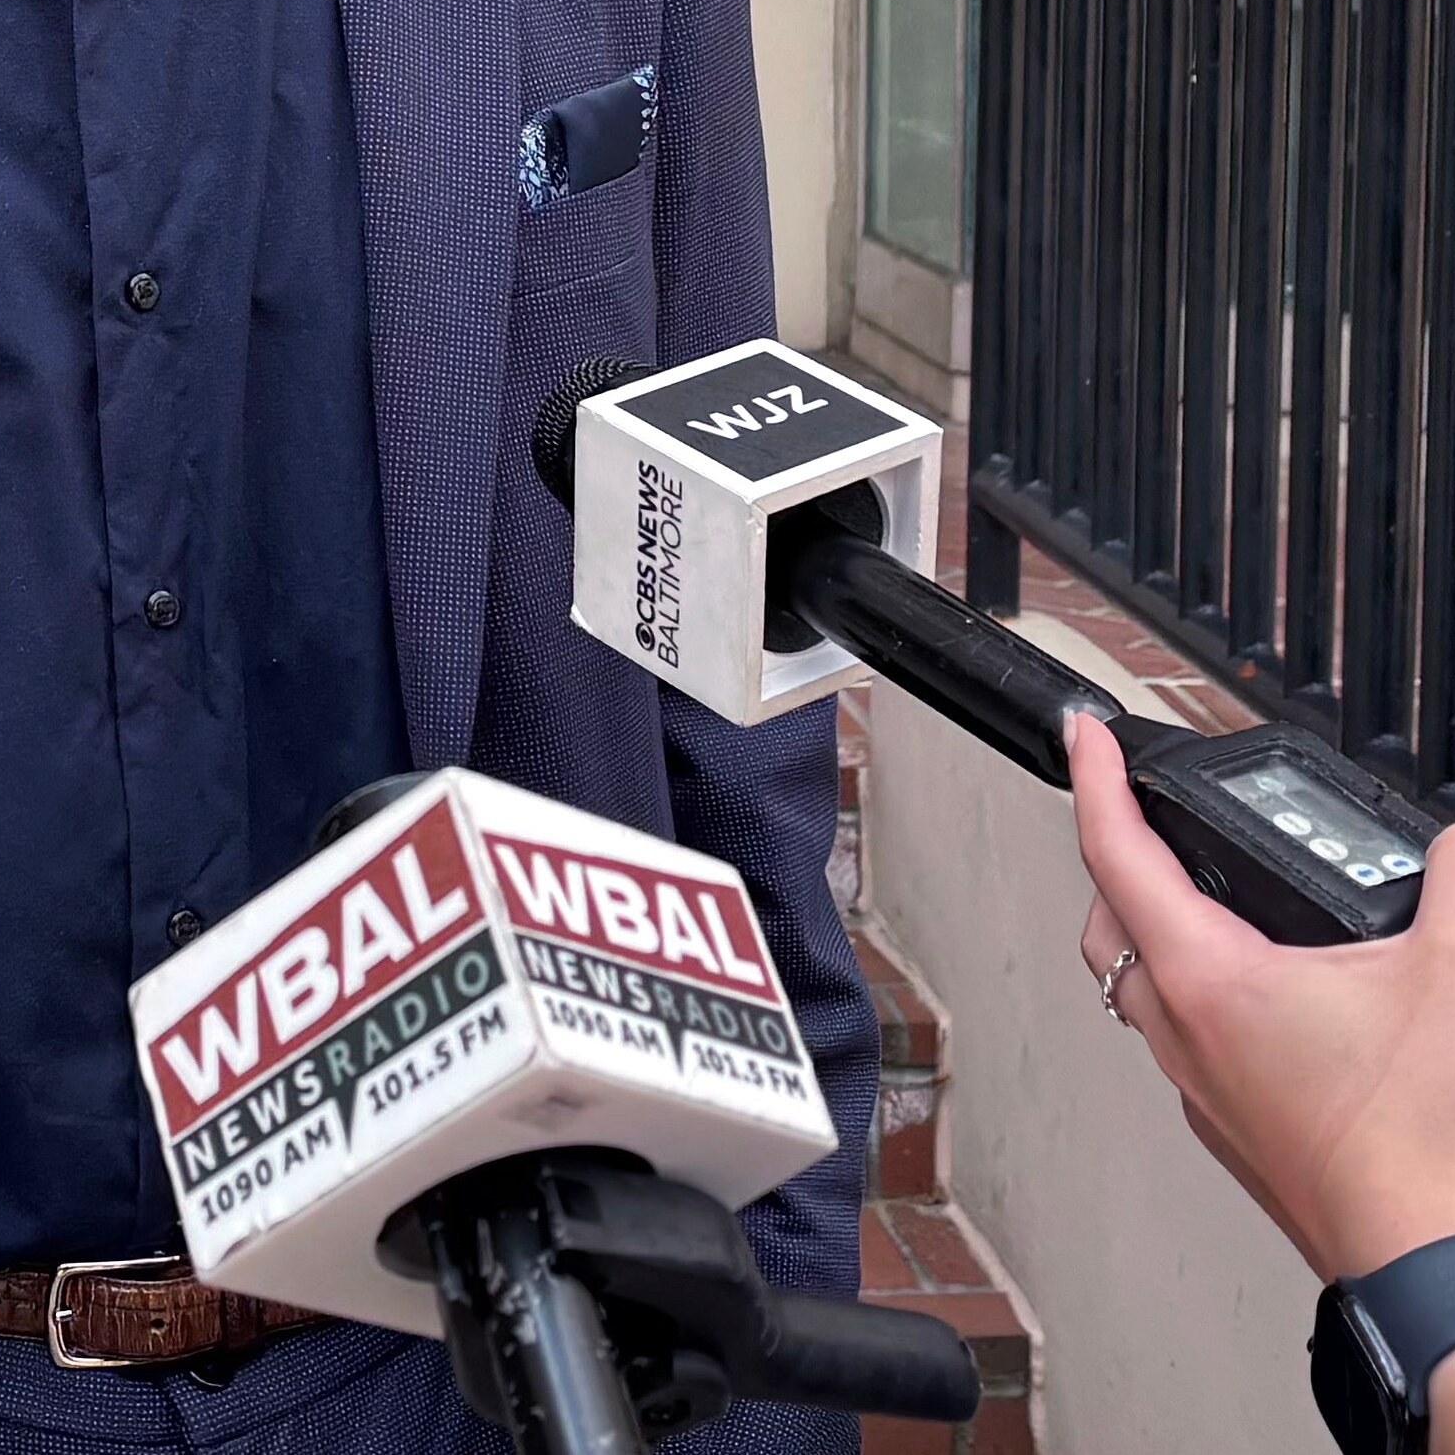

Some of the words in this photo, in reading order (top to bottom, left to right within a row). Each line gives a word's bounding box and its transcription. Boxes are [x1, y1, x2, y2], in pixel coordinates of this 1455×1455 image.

[687, 384, 829, 440] WJZ
[657, 472, 683, 669] BALTIMORE
[161, 843, 469, 1106] WBAL
[495, 843, 766, 987] WBAL
[200, 1161, 273, 1226] 1090
[283, 1117, 332, 1176] AM
[367, 1038, 453, 1116] 101.5
[459, 1007, 507, 1058] FM
[545, 996, 612, 1043] 1090
[621, 1021, 667, 1059] AM
[693, 1043, 763, 1087] 101.5
[767, 1069, 808, 1100] FM
